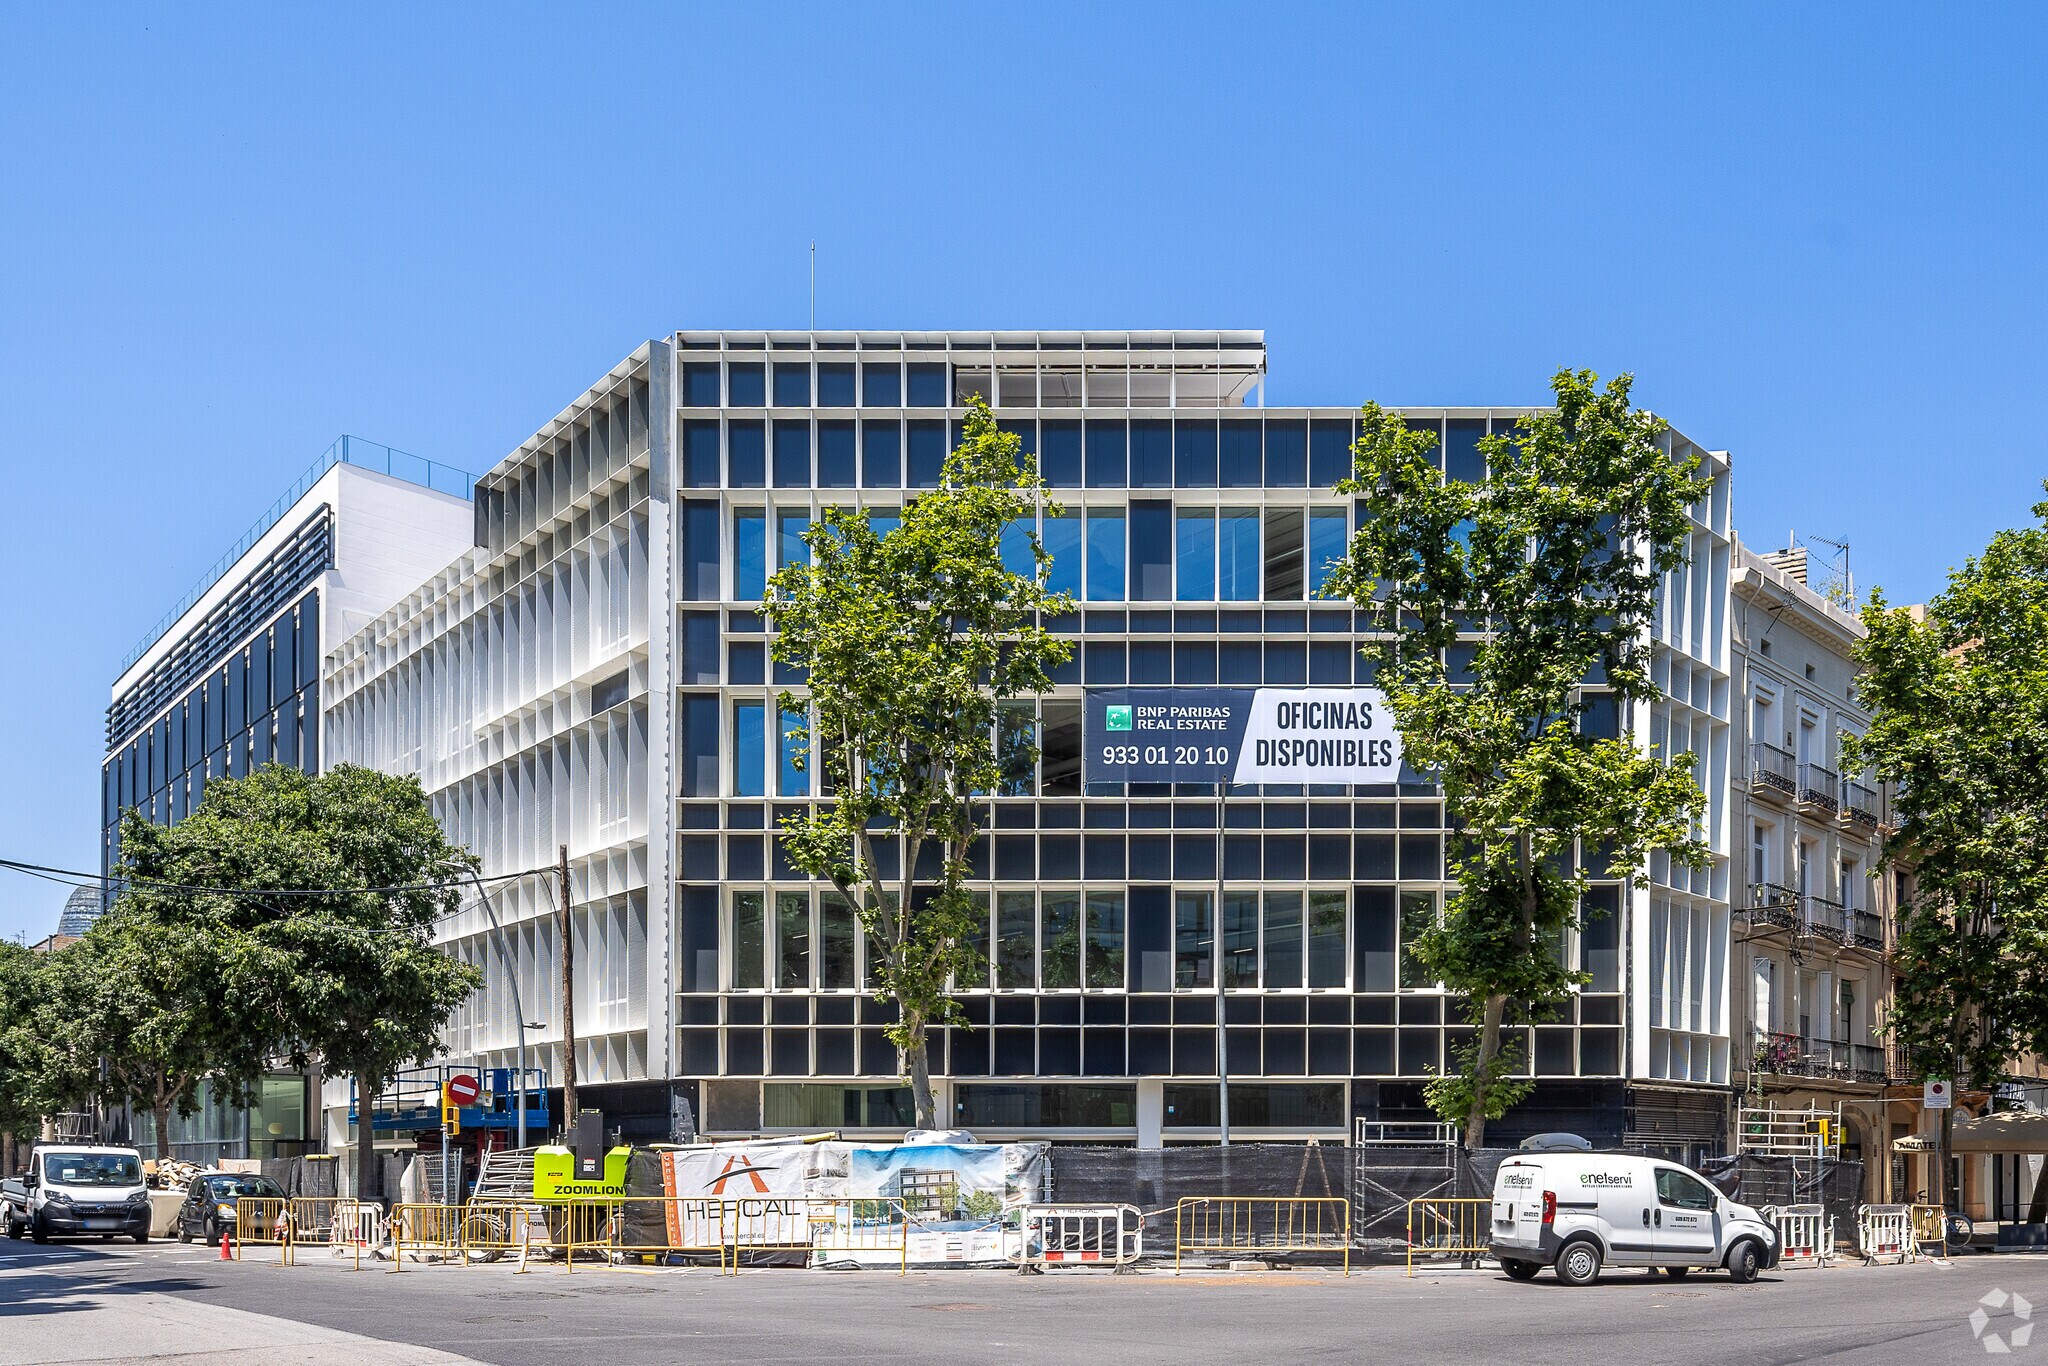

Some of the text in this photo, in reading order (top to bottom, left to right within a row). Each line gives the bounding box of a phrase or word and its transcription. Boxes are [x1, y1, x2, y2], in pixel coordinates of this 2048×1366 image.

[1137, 706, 1231, 717] BNP PARIBAS
[1277, 702, 1372, 729] OFICINAS
[1137, 719, 1227, 730] REAL ESTATE
[1103, 746, 1229, 764] 933 01 20 10
[1256, 739, 1392, 767] DISPONIBLES
[554, 1185, 624, 1194] ZOOMLION
[686, 1199, 801, 1220] HERCAL
